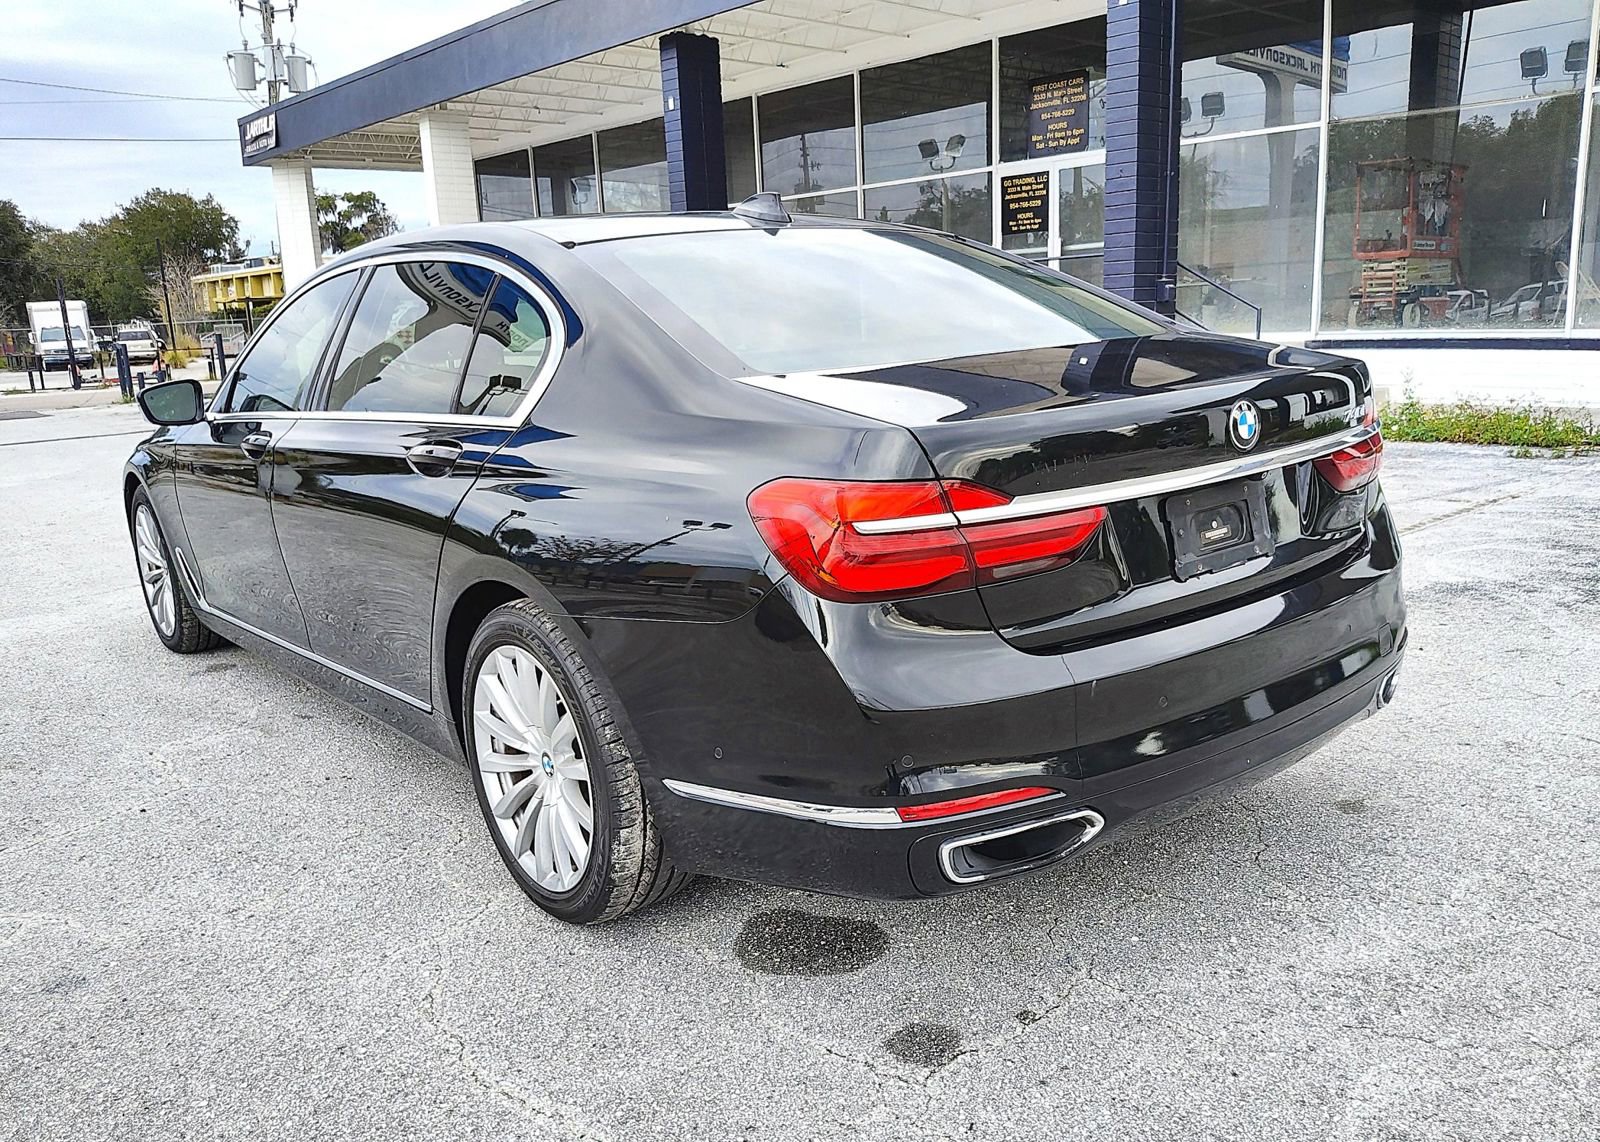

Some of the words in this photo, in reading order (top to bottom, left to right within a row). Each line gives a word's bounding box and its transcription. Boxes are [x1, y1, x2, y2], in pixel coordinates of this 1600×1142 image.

[1032, 85, 1048, 93] FIRST
[1048, 81, 1067, 90] COAST
[1068, 77, 1084, 86] CARS
[1067, 87, 1083, 95] Street
[1048, 122, 1068, 131] HOURS
[1048, 140, 1058, 148] Sun
[1067, 137, 1080, 146] Appt
